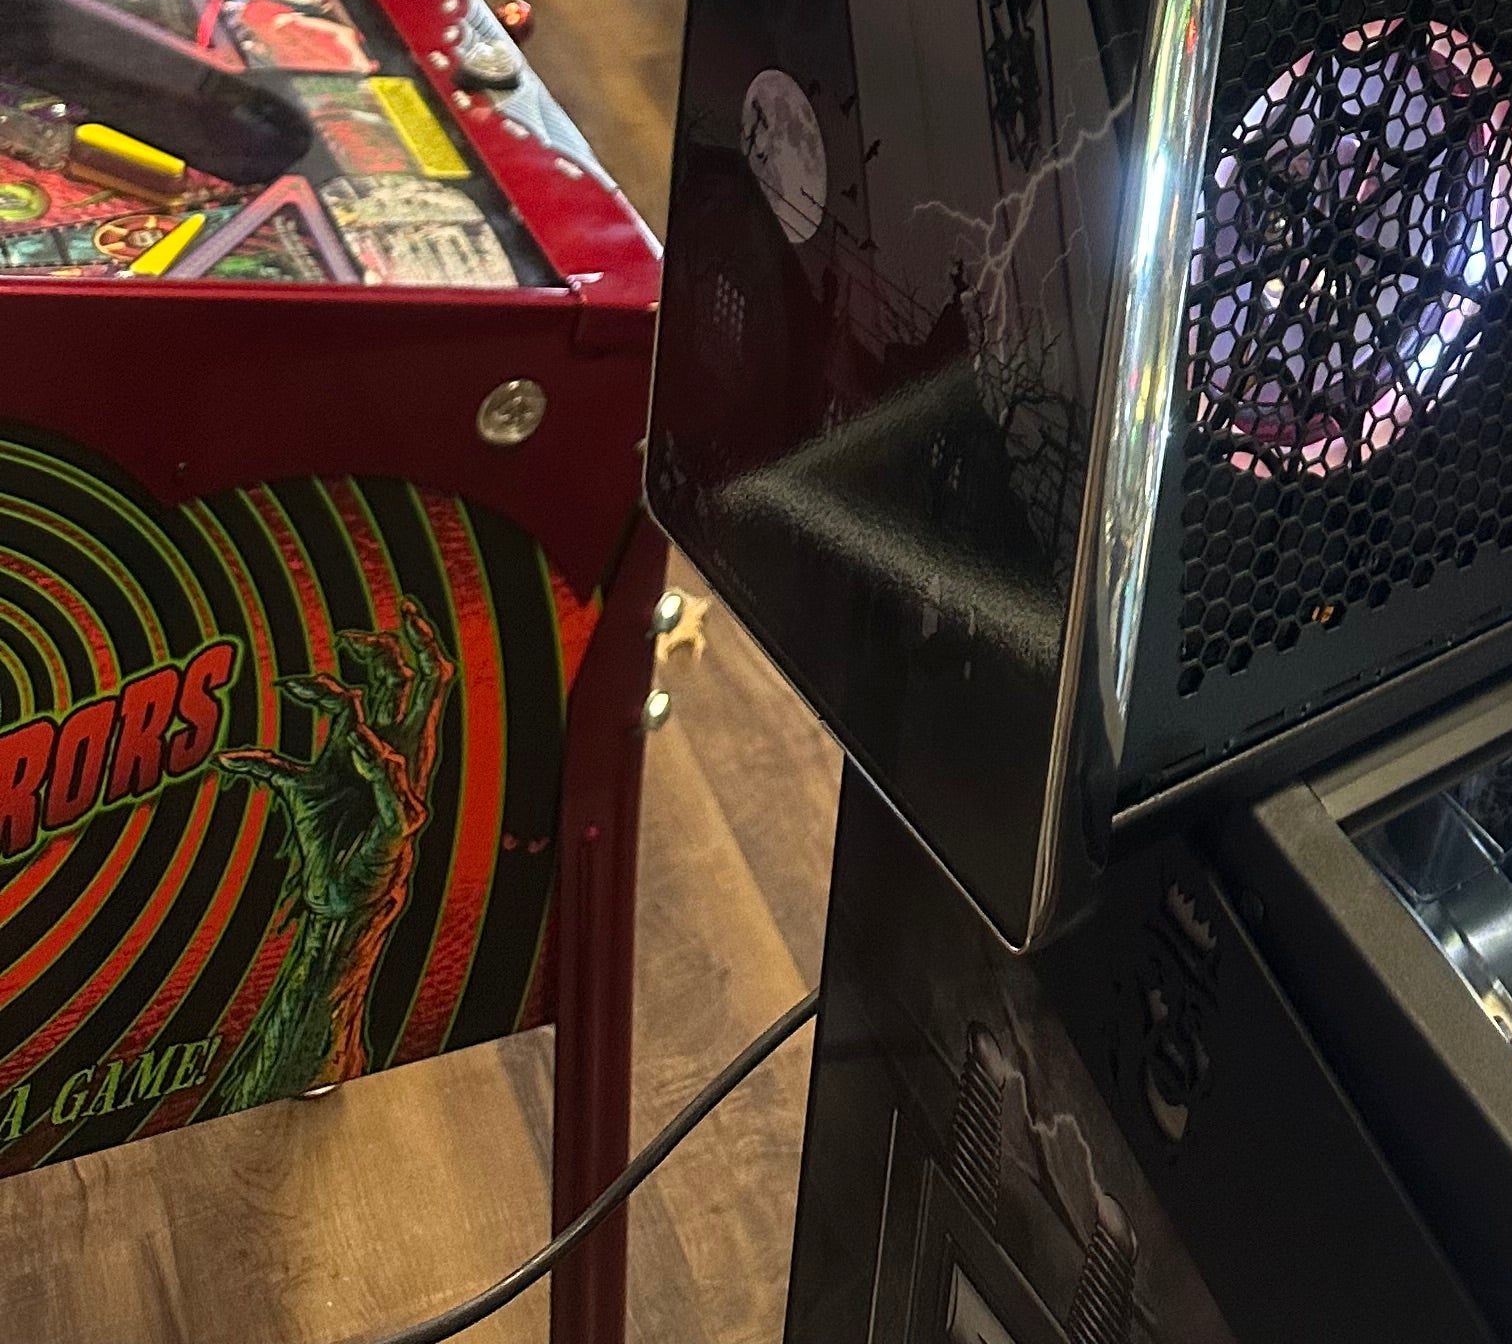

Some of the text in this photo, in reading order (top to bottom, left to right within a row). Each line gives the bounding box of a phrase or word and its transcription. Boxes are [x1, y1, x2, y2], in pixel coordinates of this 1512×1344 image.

[0, 643, 236, 858] RORS
[0, 1035, 223, 1141] A GAME!
